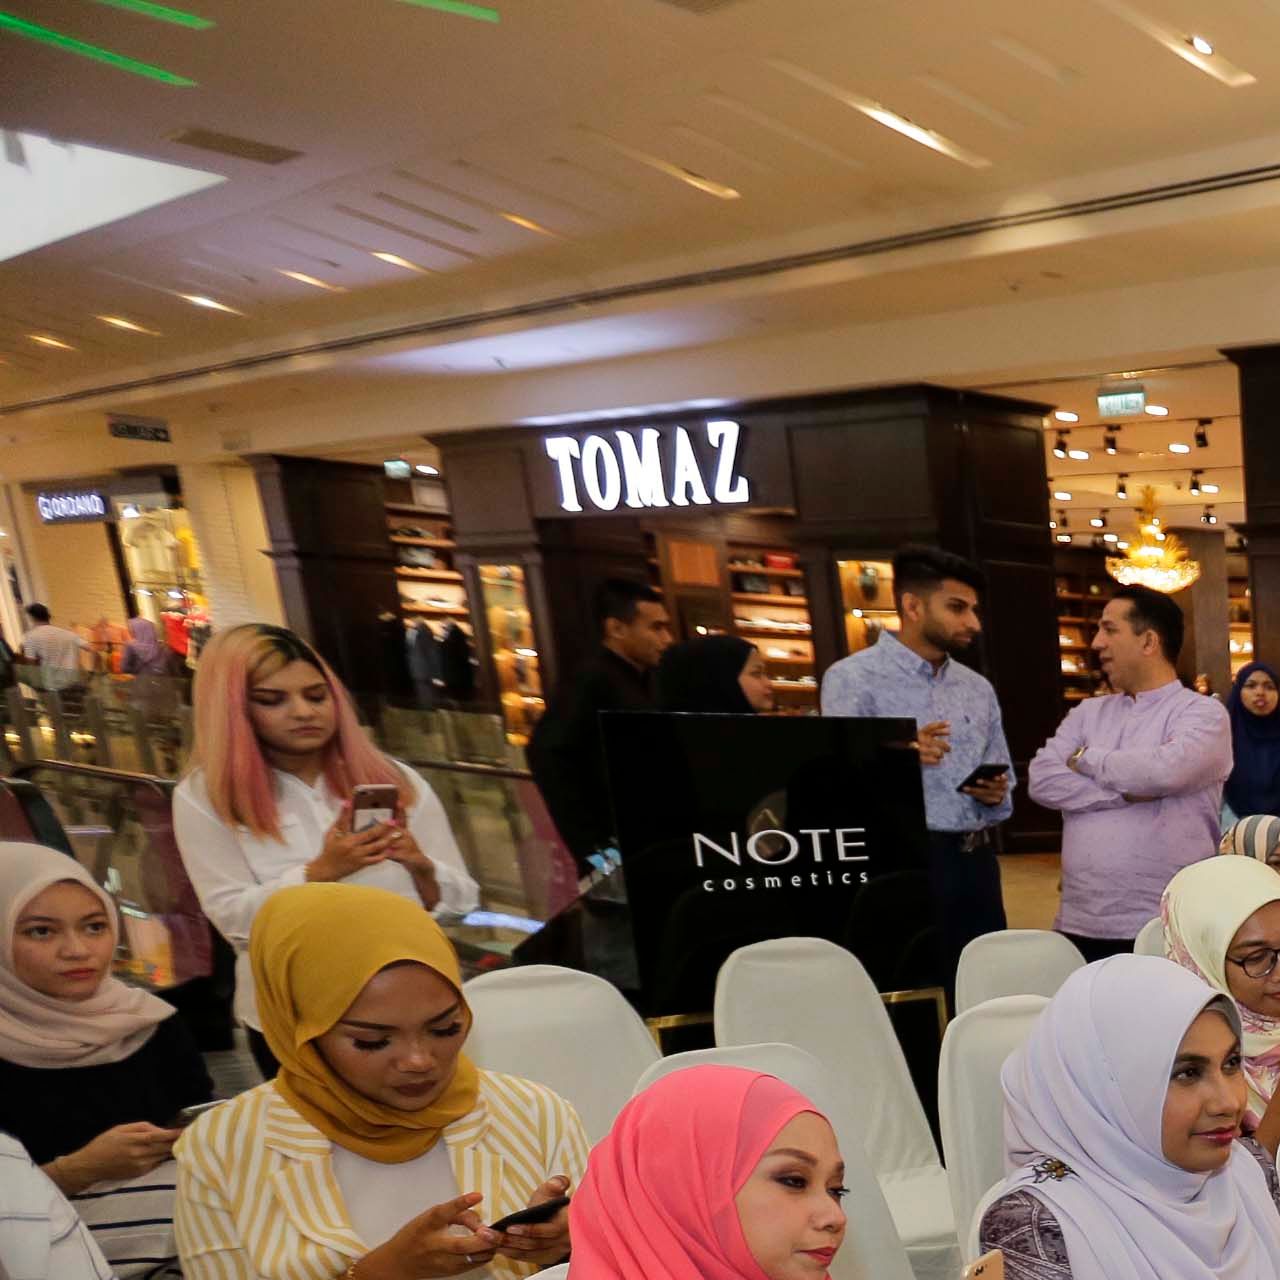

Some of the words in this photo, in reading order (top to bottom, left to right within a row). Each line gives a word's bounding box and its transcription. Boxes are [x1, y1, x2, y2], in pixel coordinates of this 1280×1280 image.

[545, 420, 750, 512] TOMAZ
[692, 828, 870, 868] NOTE
[703, 870, 869, 892] cosmetics
